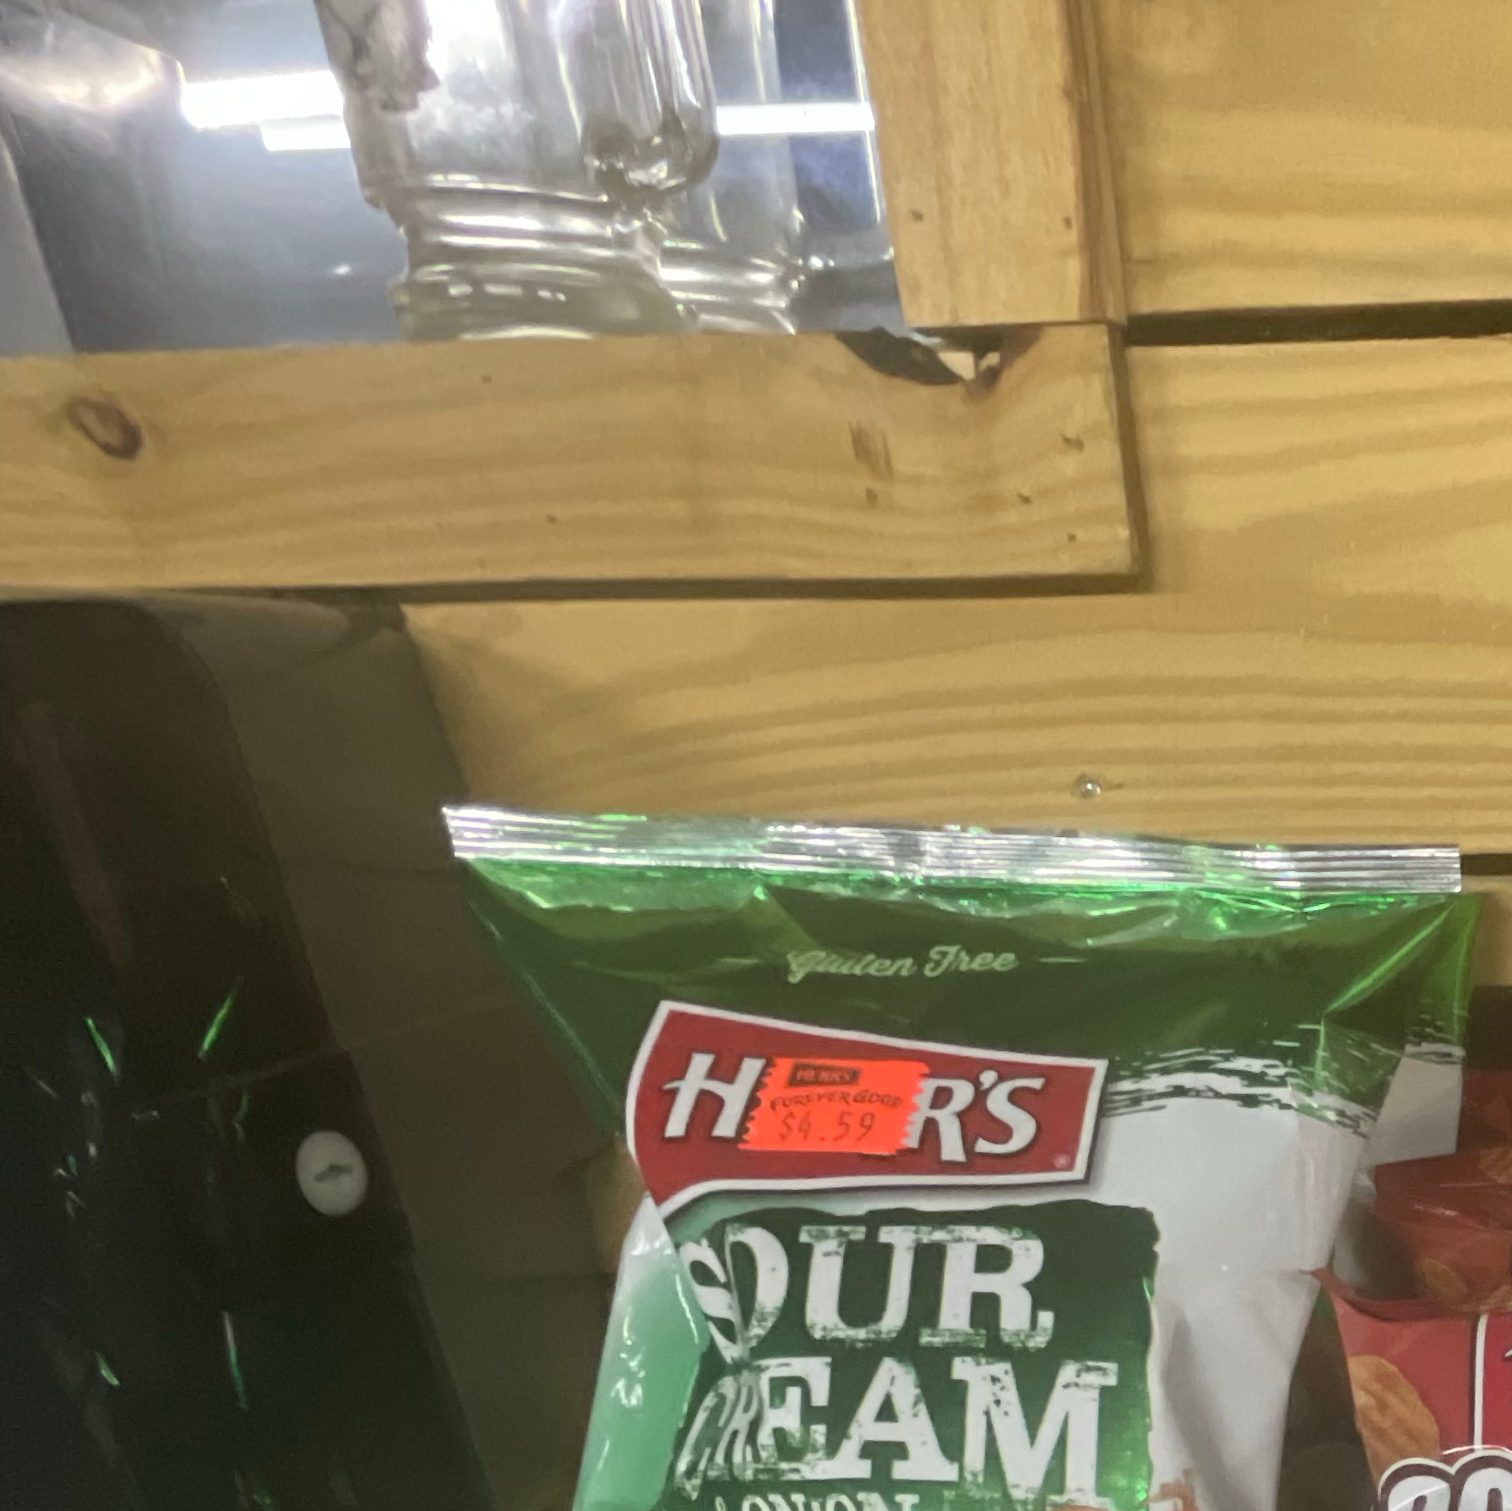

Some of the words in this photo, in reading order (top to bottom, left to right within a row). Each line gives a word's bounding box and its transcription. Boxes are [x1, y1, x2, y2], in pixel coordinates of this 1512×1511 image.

[786, 950, 918, 984] Gluten
[923, 944, 1019, 977] Free
[662, 1051, 1046, 1164] HR'S
[778, 1110, 876, 1142] $4.59
